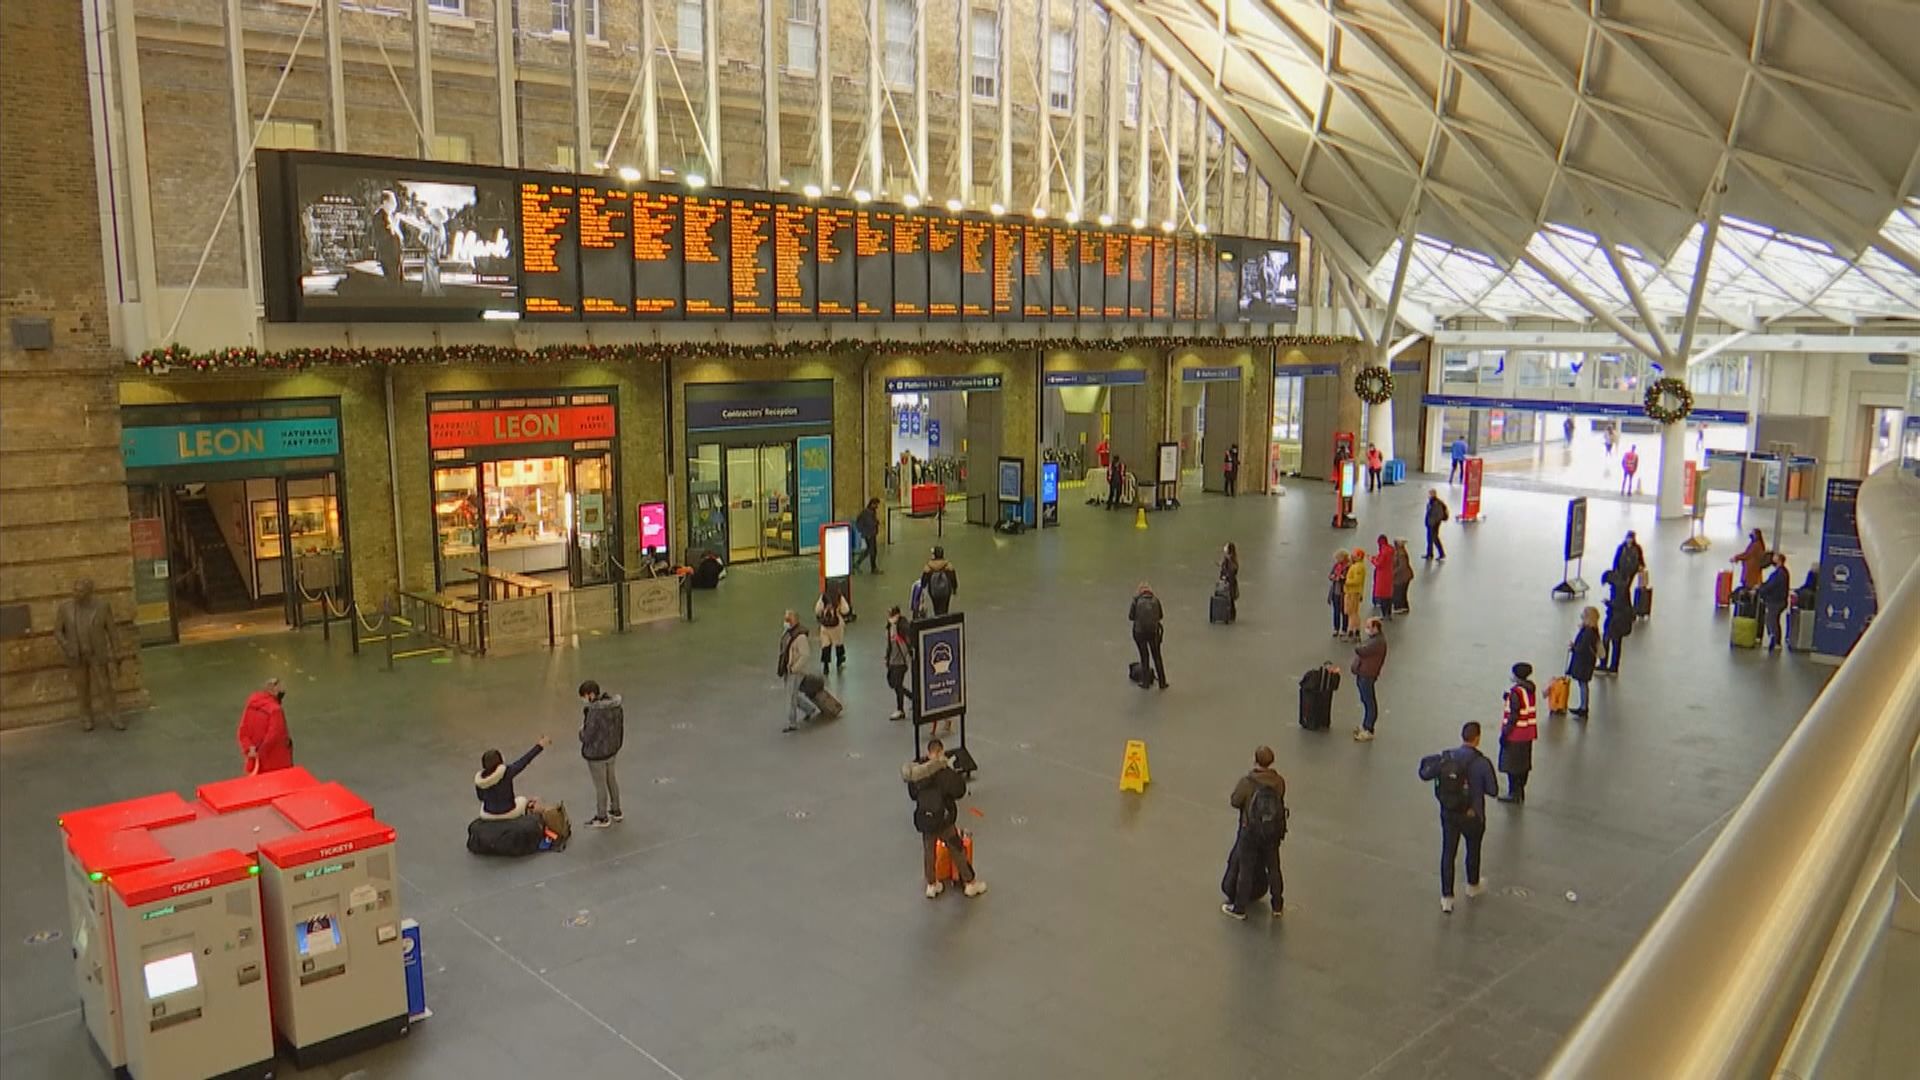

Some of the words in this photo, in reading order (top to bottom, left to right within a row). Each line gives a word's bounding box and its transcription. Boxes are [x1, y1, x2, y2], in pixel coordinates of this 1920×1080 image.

[765, 406, 798, 418] Reception
[281, 428, 333, 438] NATURALLY
[493, 413, 561, 439] LEON
[177, 428, 265, 458] LEON
[320, 842, 354, 858] TICKETS
[172, 877, 211, 894] TICKETS
